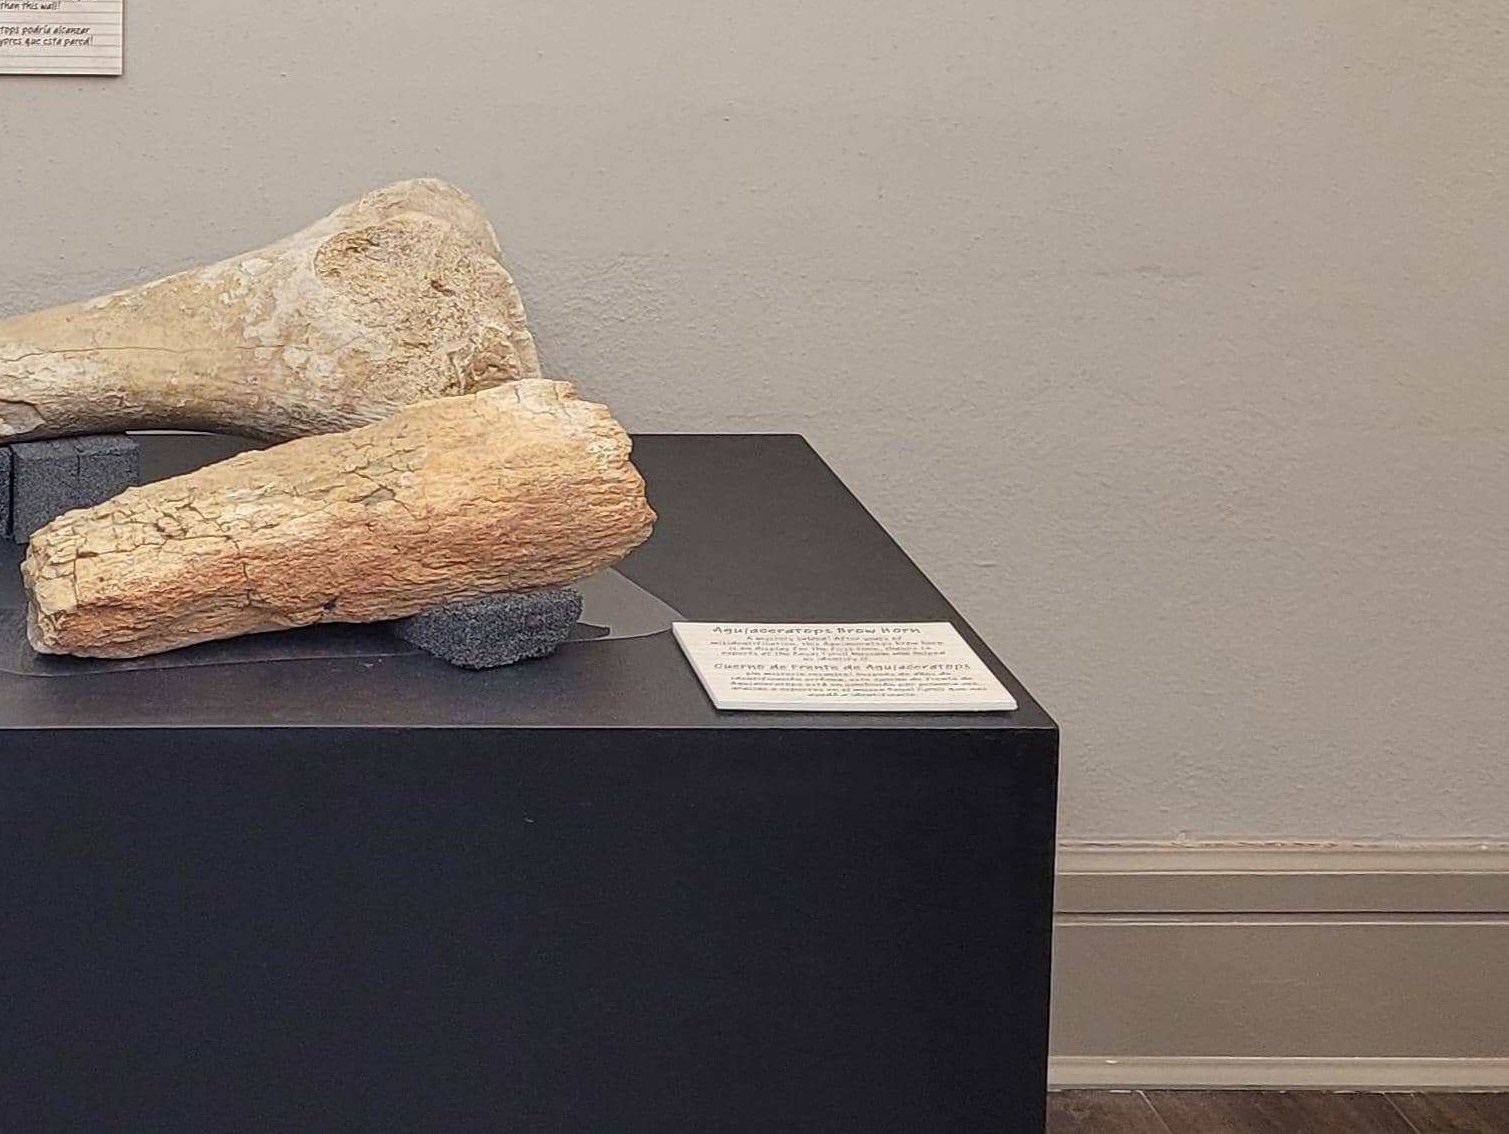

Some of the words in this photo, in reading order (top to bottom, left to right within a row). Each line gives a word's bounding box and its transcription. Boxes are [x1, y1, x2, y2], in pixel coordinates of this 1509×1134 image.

[0, 1, 20, 10] than
[22, 1, 38, 10] this
[40, 0, 61, 10] wall!
[22, 25, 51, 35] podría
[53, 26, 90, 34] alcanzar
[24, 38, 41, 47] que
[42, 38, 62, 46] esta
[63, 36, 93, 47] pared!
